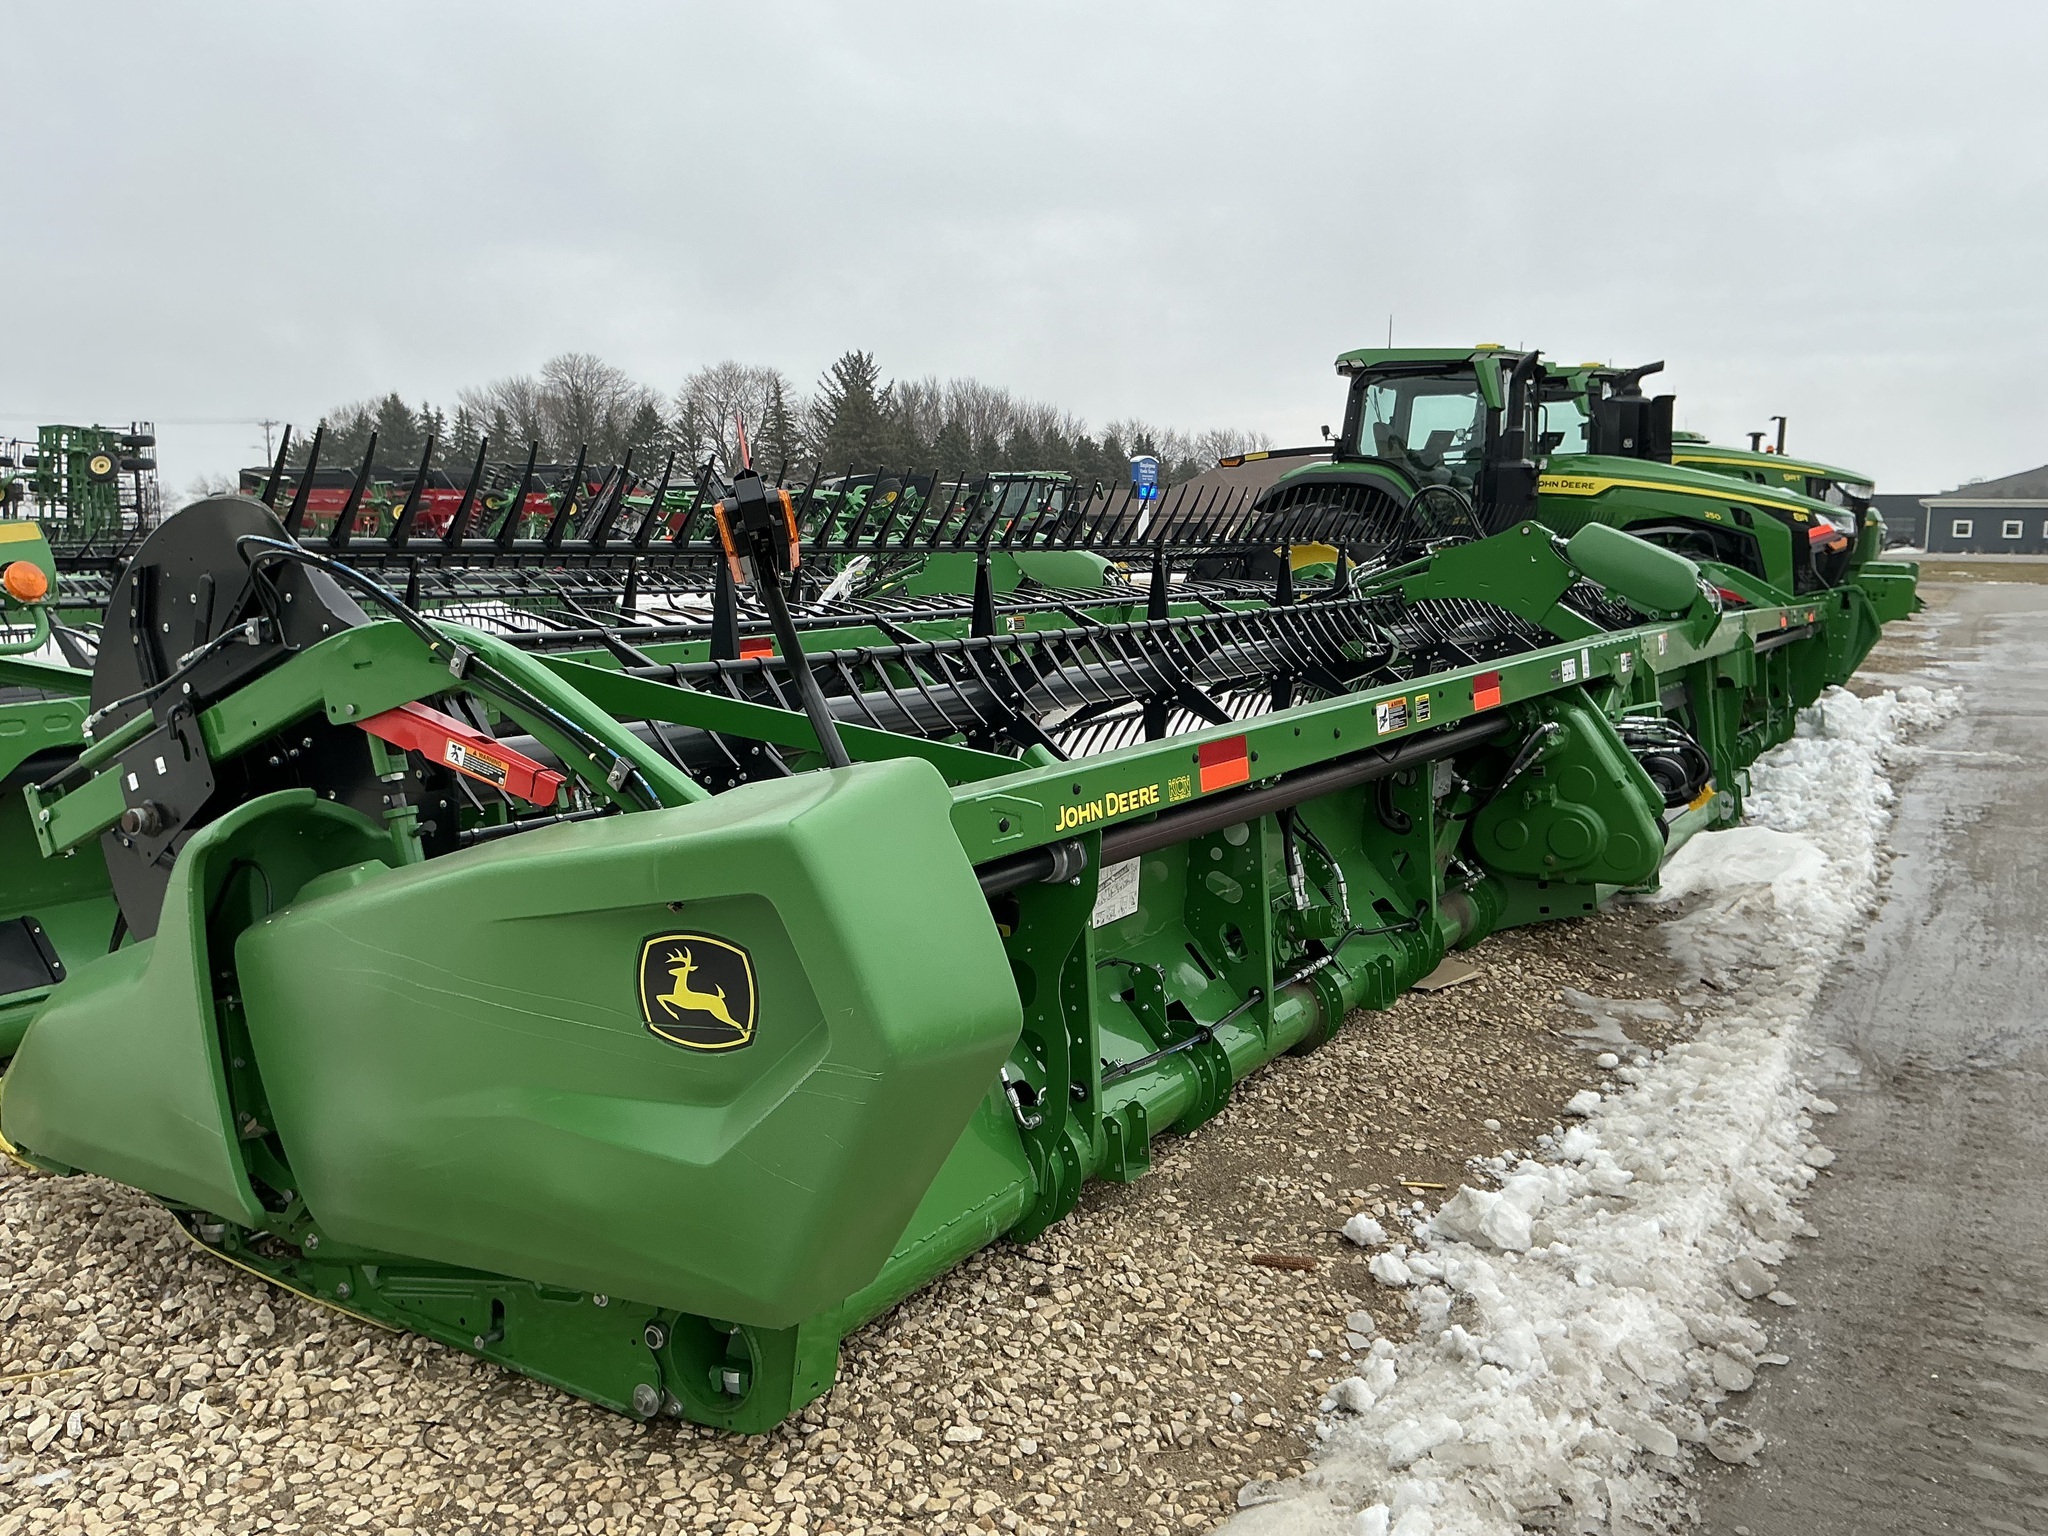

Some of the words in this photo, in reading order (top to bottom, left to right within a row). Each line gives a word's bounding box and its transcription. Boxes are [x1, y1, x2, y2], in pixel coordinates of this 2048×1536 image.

[1538, 480, 1559, 488] OHN
[1561, 480, 1595, 489] DEERE
[478, 752, 502, 767] WARNING
[1055, 799, 1103, 832] JOHN
[1105, 784, 1160, 817] DEERE
